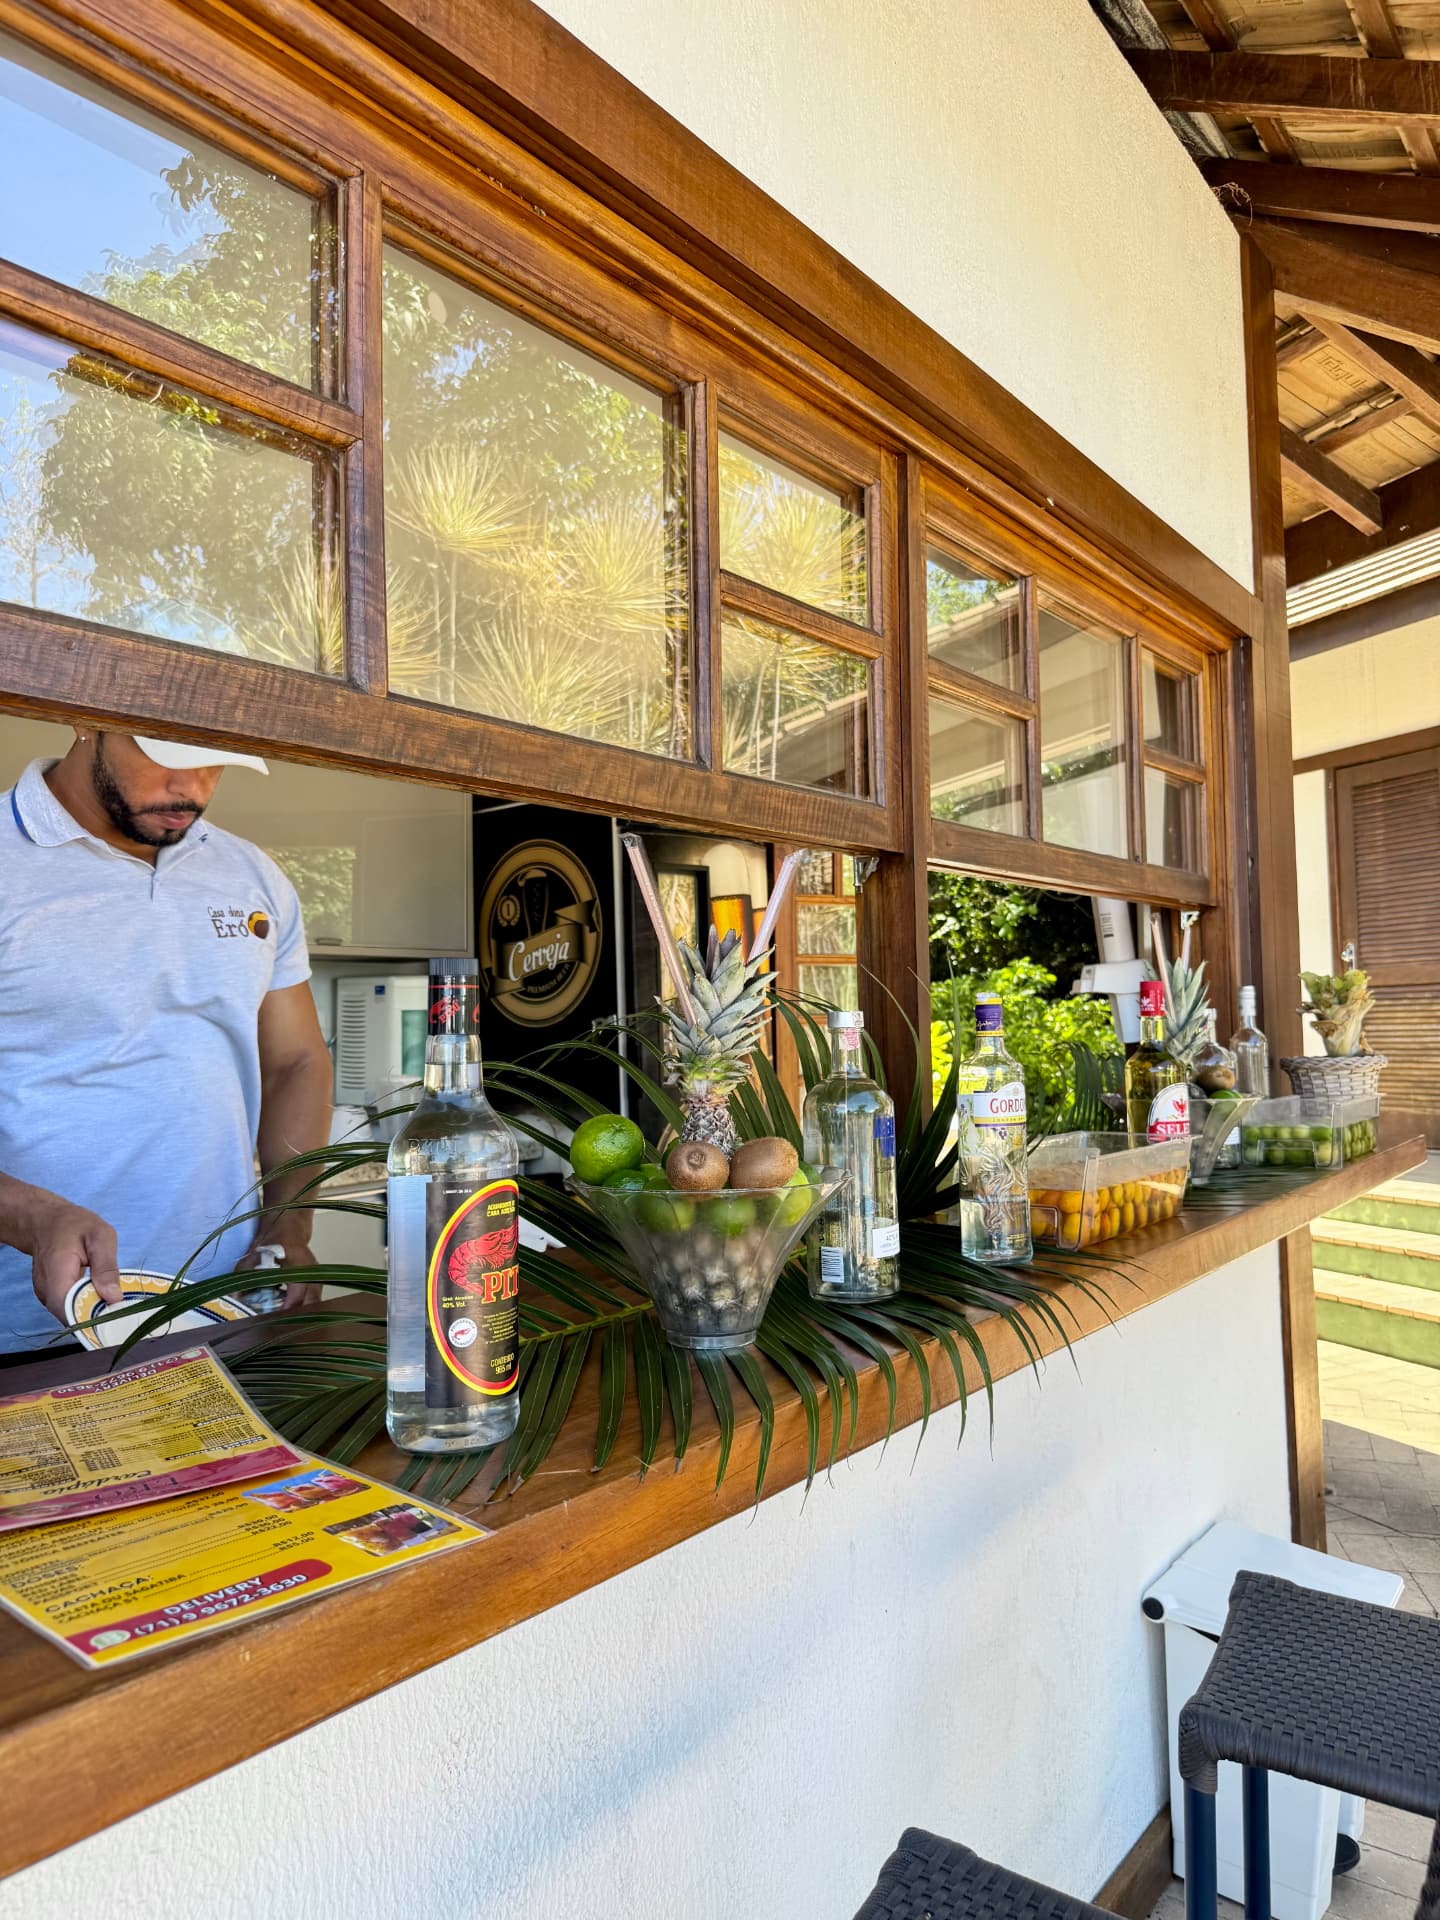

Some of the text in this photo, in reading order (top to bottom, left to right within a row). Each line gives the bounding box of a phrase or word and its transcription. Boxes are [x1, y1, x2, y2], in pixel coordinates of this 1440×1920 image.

[208, 906, 225, 918] Casa
[210, 919, 249, 938] Eró
[508, 933, 570, 982] Cerveja
[94, 1368, 157, 1393] DELIVERY
[45, 1577, 154, 1613] CACHAÇA:
[134, 1617, 180, 1636] (71)
[201, 1574, 307, 1615] 9672-3630
[163, 1576, 262, 1615] DELIVERY
